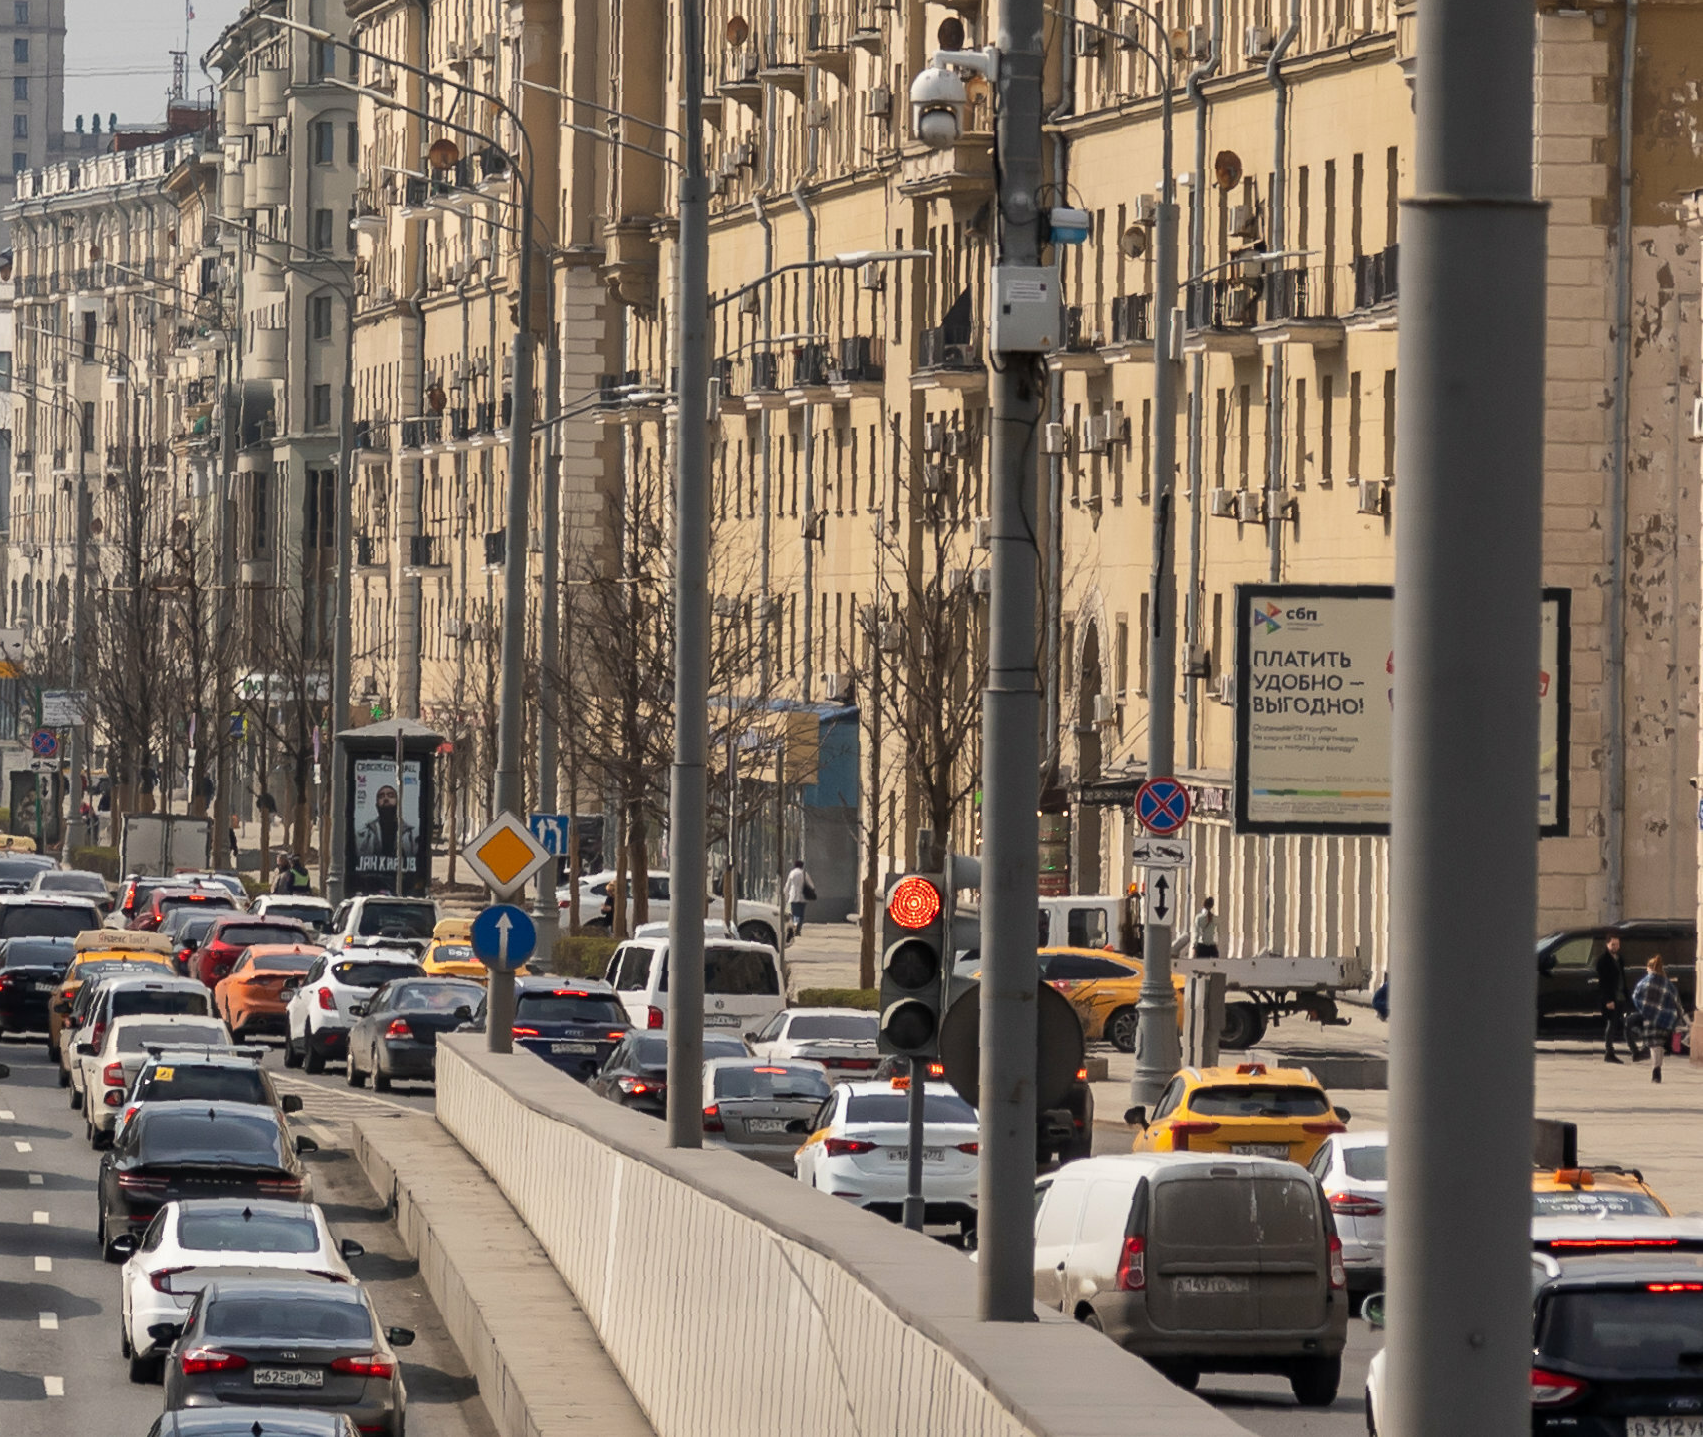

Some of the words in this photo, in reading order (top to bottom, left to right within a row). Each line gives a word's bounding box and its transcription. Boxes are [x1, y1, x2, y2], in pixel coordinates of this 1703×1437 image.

[1285, 607, 1318, 622] сбп
[1253, 650, 1352, 668] ПЛАТИТЬ
[1253, 673, 1343, 692] УДОБНО
[1253, 695, 1365, 716] ВЫГОДНО!
